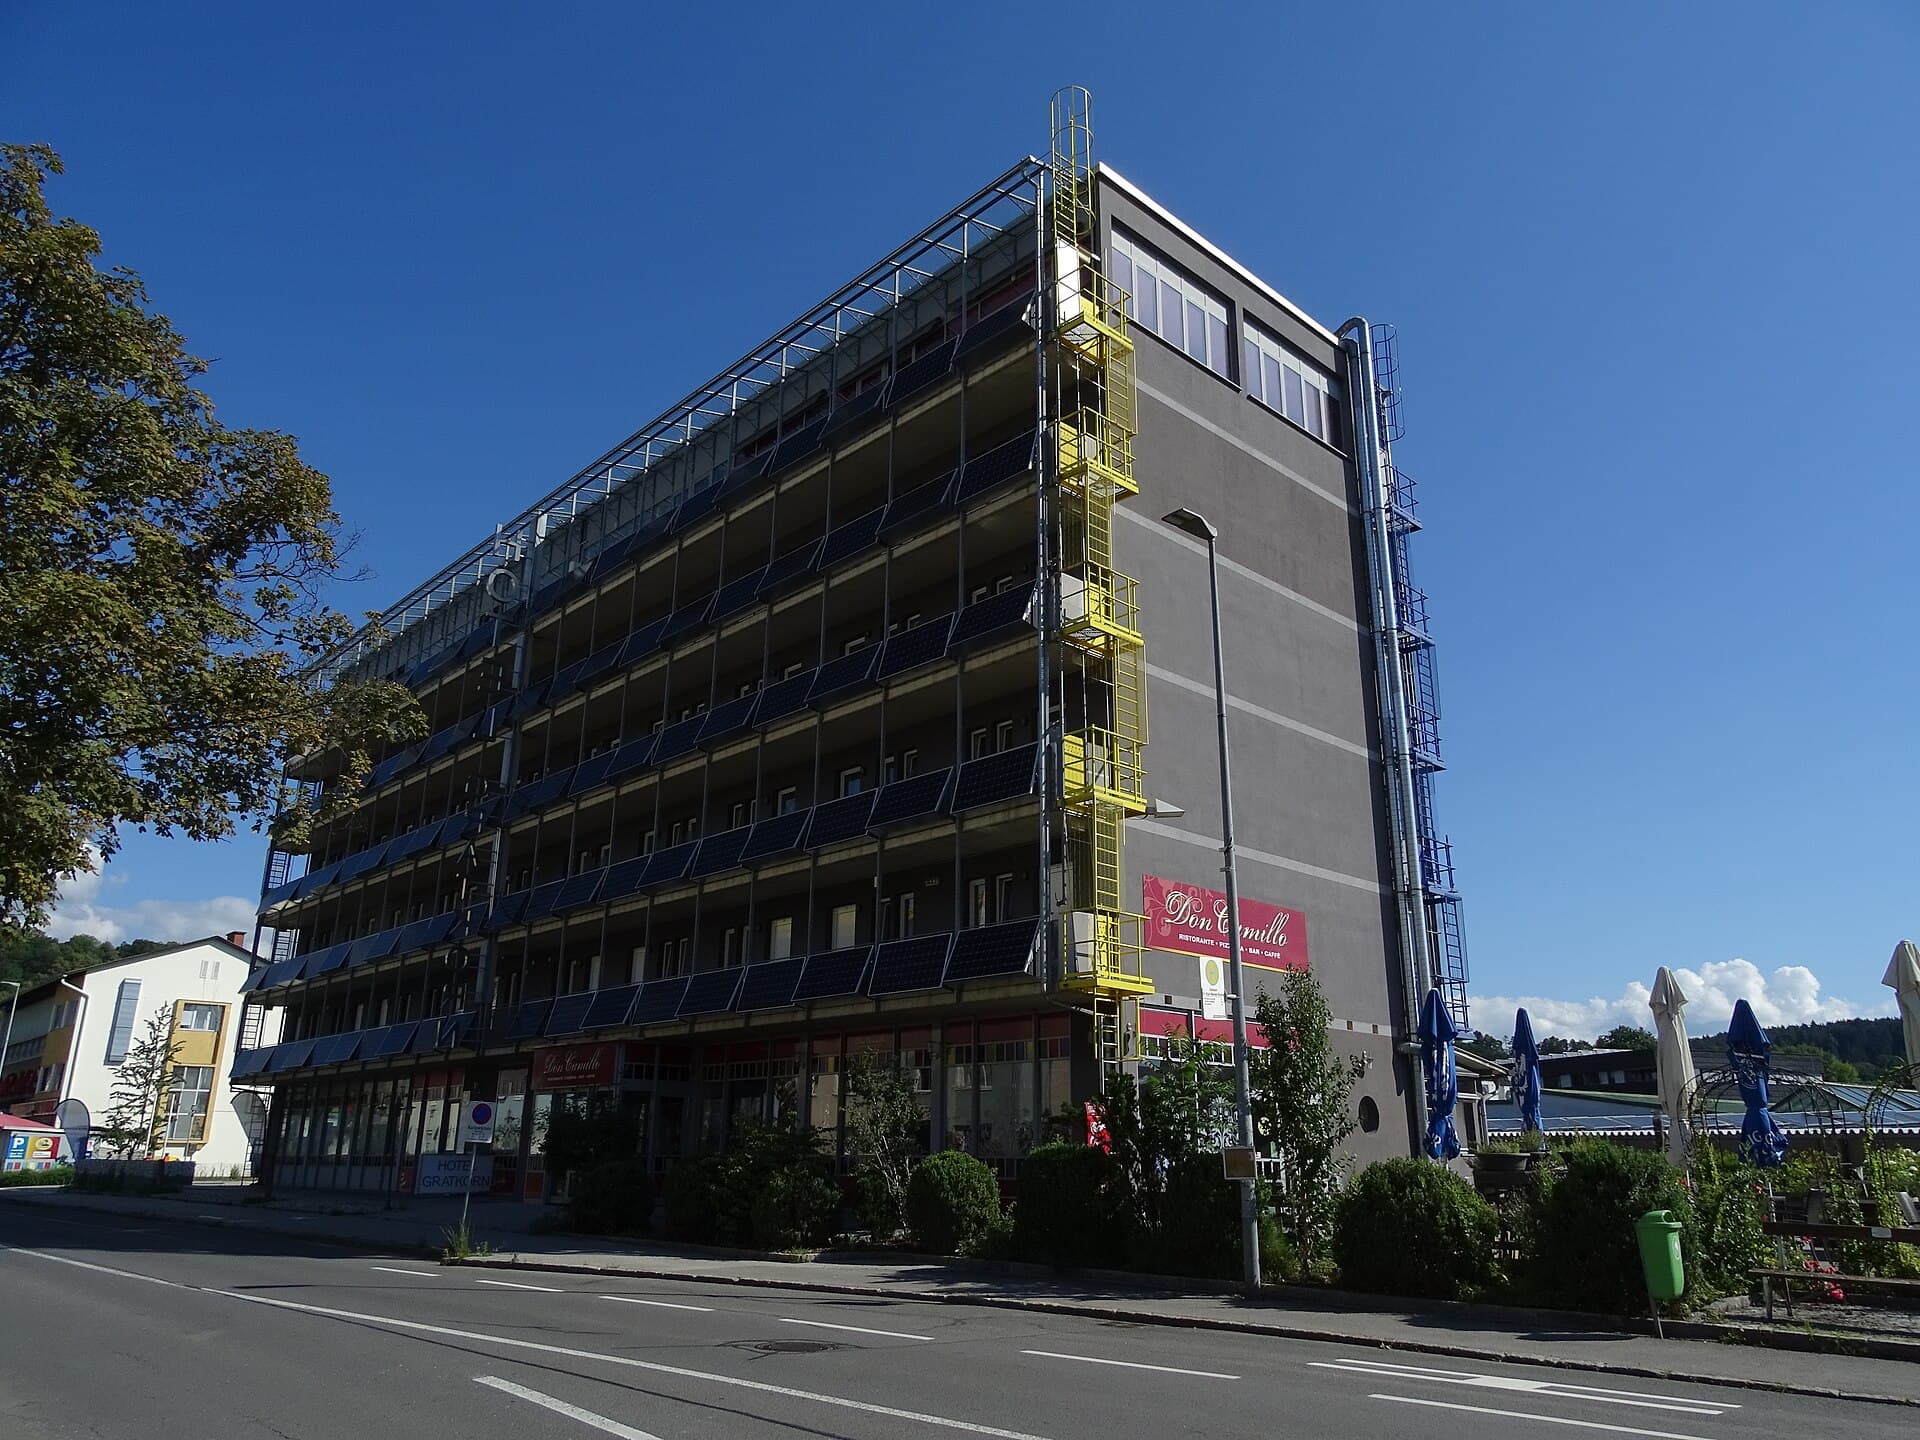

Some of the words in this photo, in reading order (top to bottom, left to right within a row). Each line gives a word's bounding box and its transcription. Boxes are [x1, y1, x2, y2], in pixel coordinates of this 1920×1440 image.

[1165, 890, 1213, 931] Don
[1213, 899, 1289, 947] Cmillo
[1178, 933, 1215, 946] RISTORANTE
[1248, 947, 1261, 955] BAR
